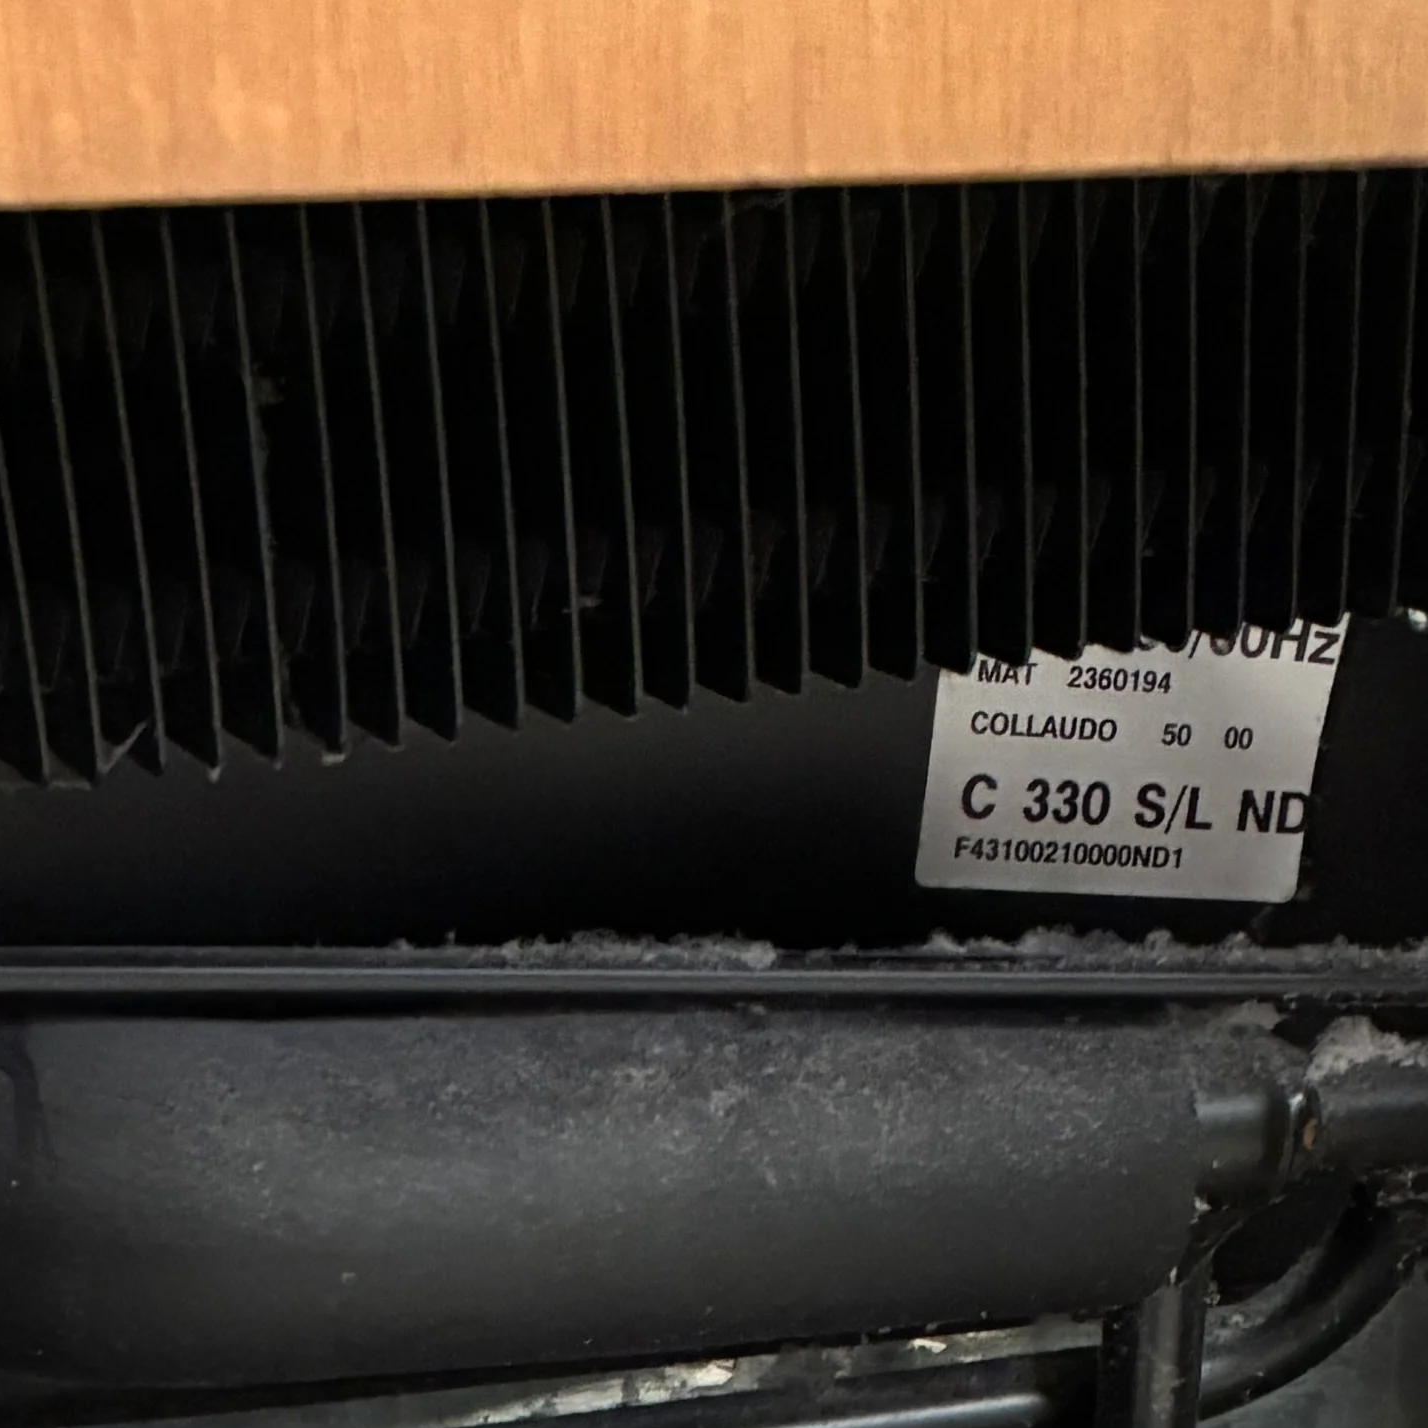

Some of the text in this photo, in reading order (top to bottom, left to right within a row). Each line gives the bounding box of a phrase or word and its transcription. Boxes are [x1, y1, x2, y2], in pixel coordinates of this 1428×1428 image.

[977, 659, 1172, 694] MAT 2360194
[970, 710, 1255, 751] COLLAUDO 50 00
[960, 774, 1309, 834] C 330 S/L ND
[953, 836, 1184, 869] F43100210000ND1
